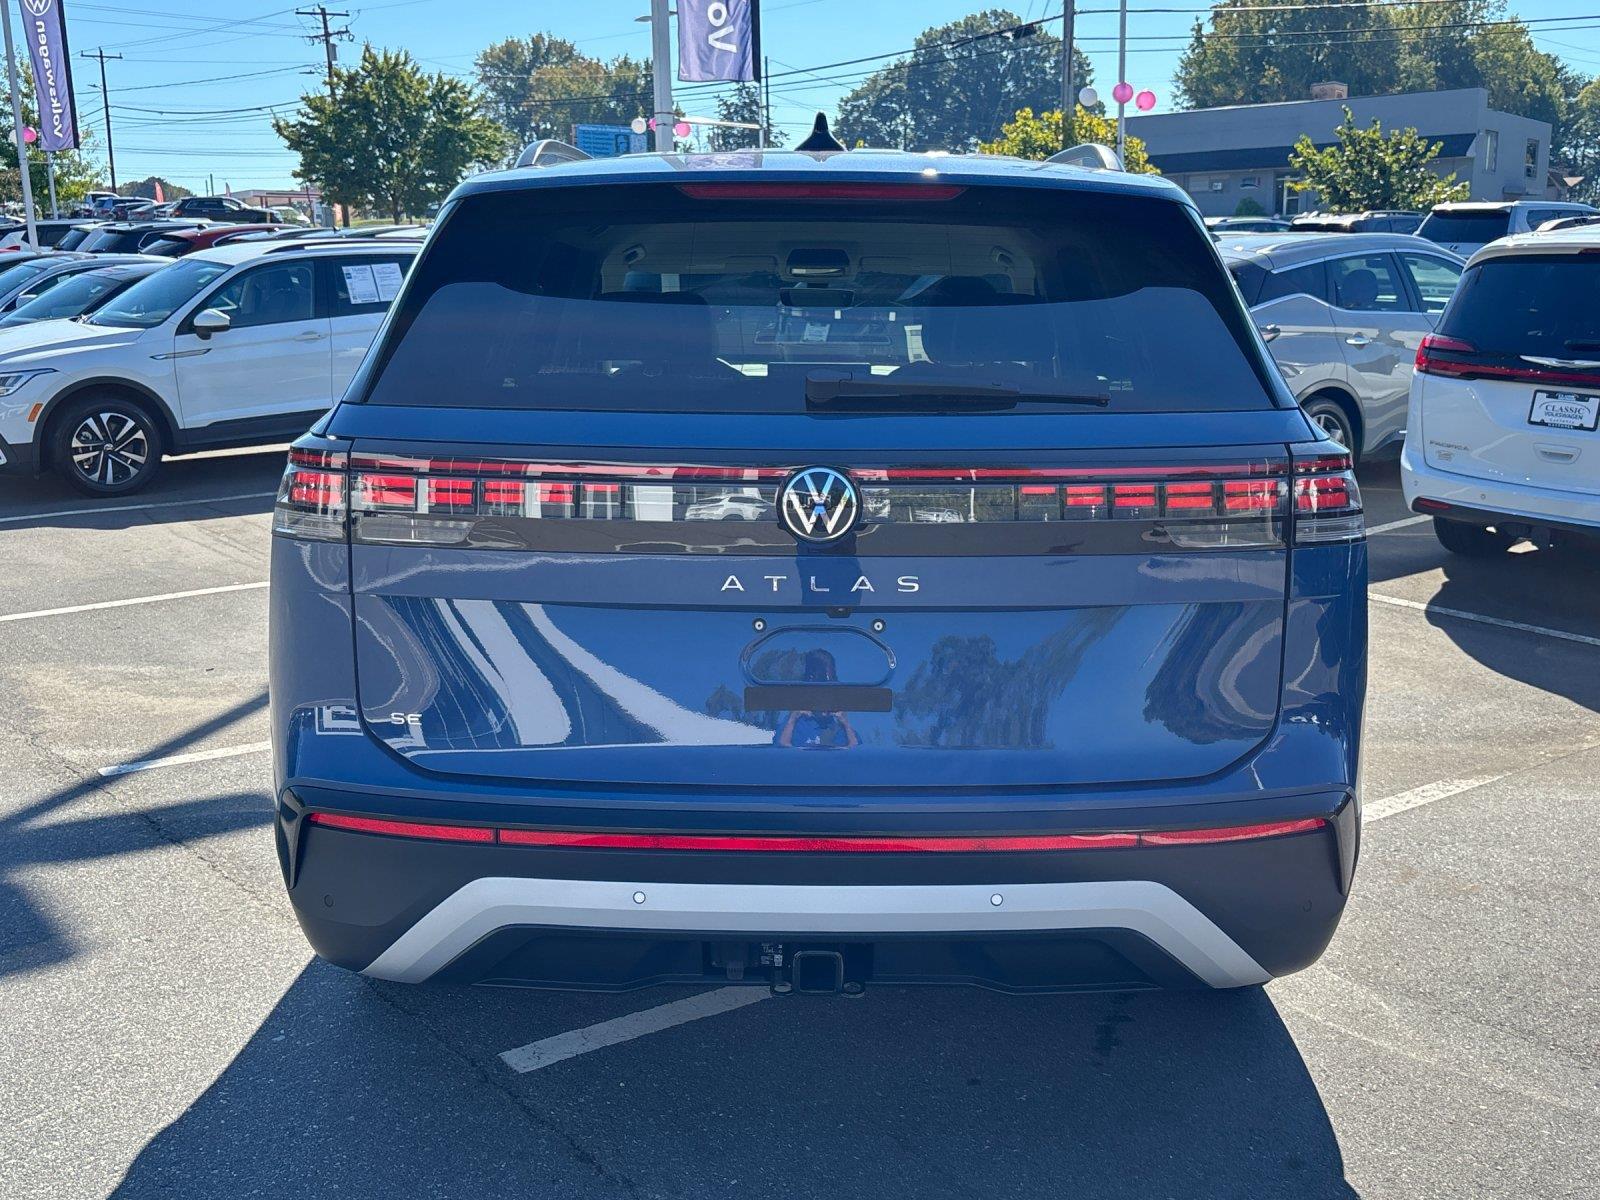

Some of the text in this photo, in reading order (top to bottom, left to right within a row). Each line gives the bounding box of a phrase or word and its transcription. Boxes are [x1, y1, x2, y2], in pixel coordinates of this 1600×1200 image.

[1545, 404, 1585, 414] CLASSIC
[1544, 411, 1584, 420] VOLKSWAGEN
[720, 575, 920, 592] ATLAS
[390, 712, 422, 726] SE
